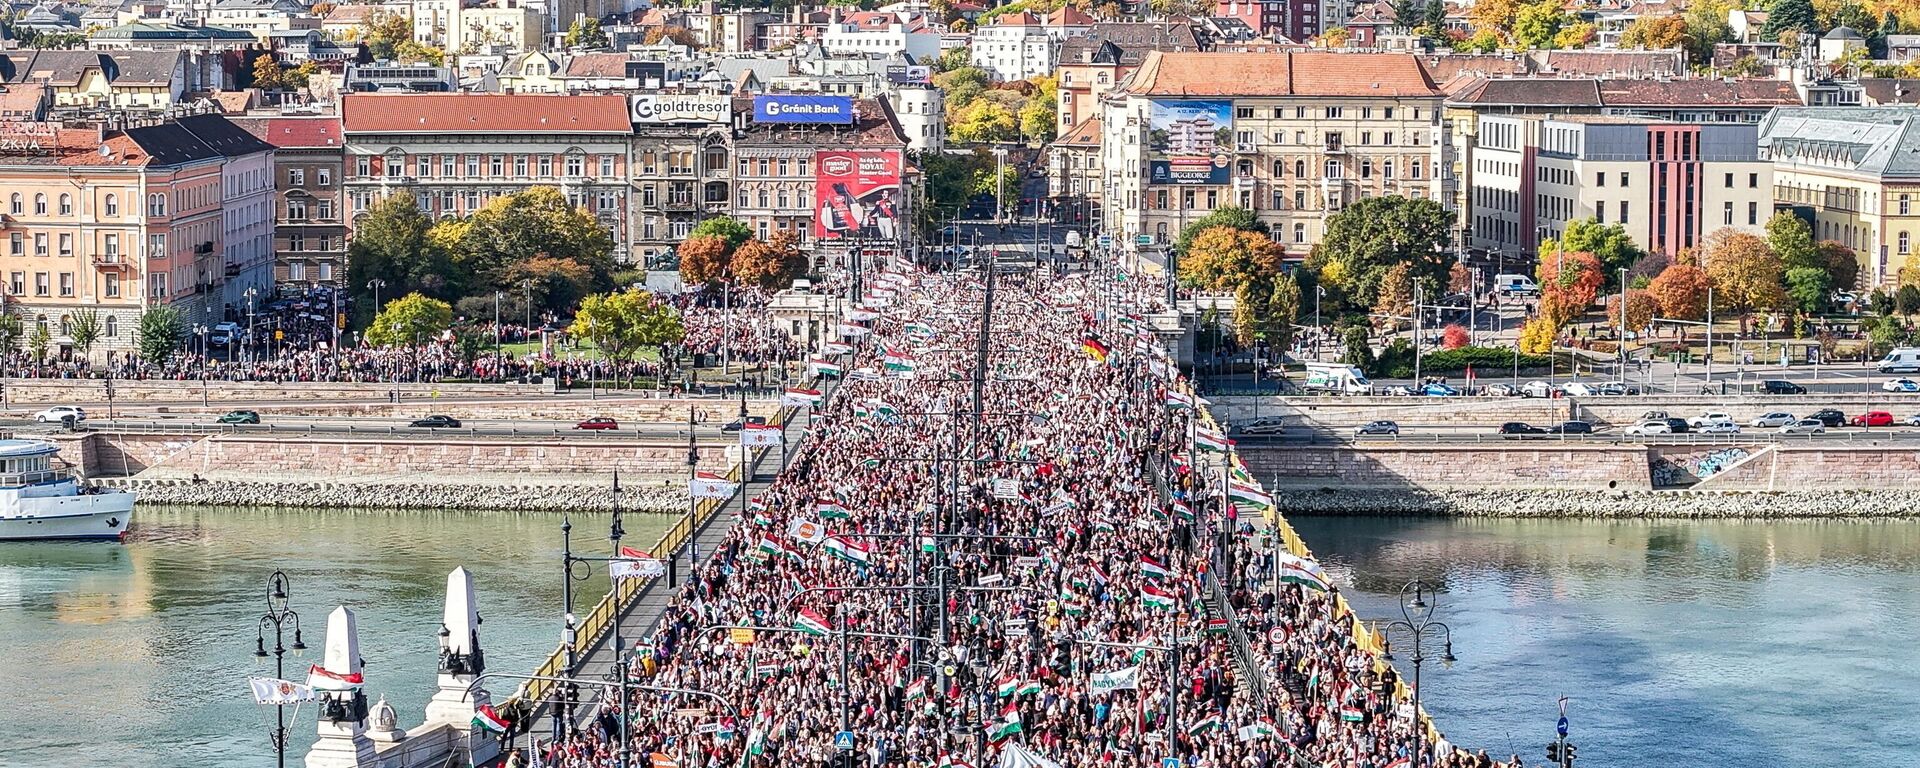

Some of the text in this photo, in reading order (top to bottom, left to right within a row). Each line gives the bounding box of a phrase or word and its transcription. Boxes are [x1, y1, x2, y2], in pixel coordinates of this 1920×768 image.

[654, 101, 729, 114] goldtresor
[782, 104, 839, 114] Gránit Bank
